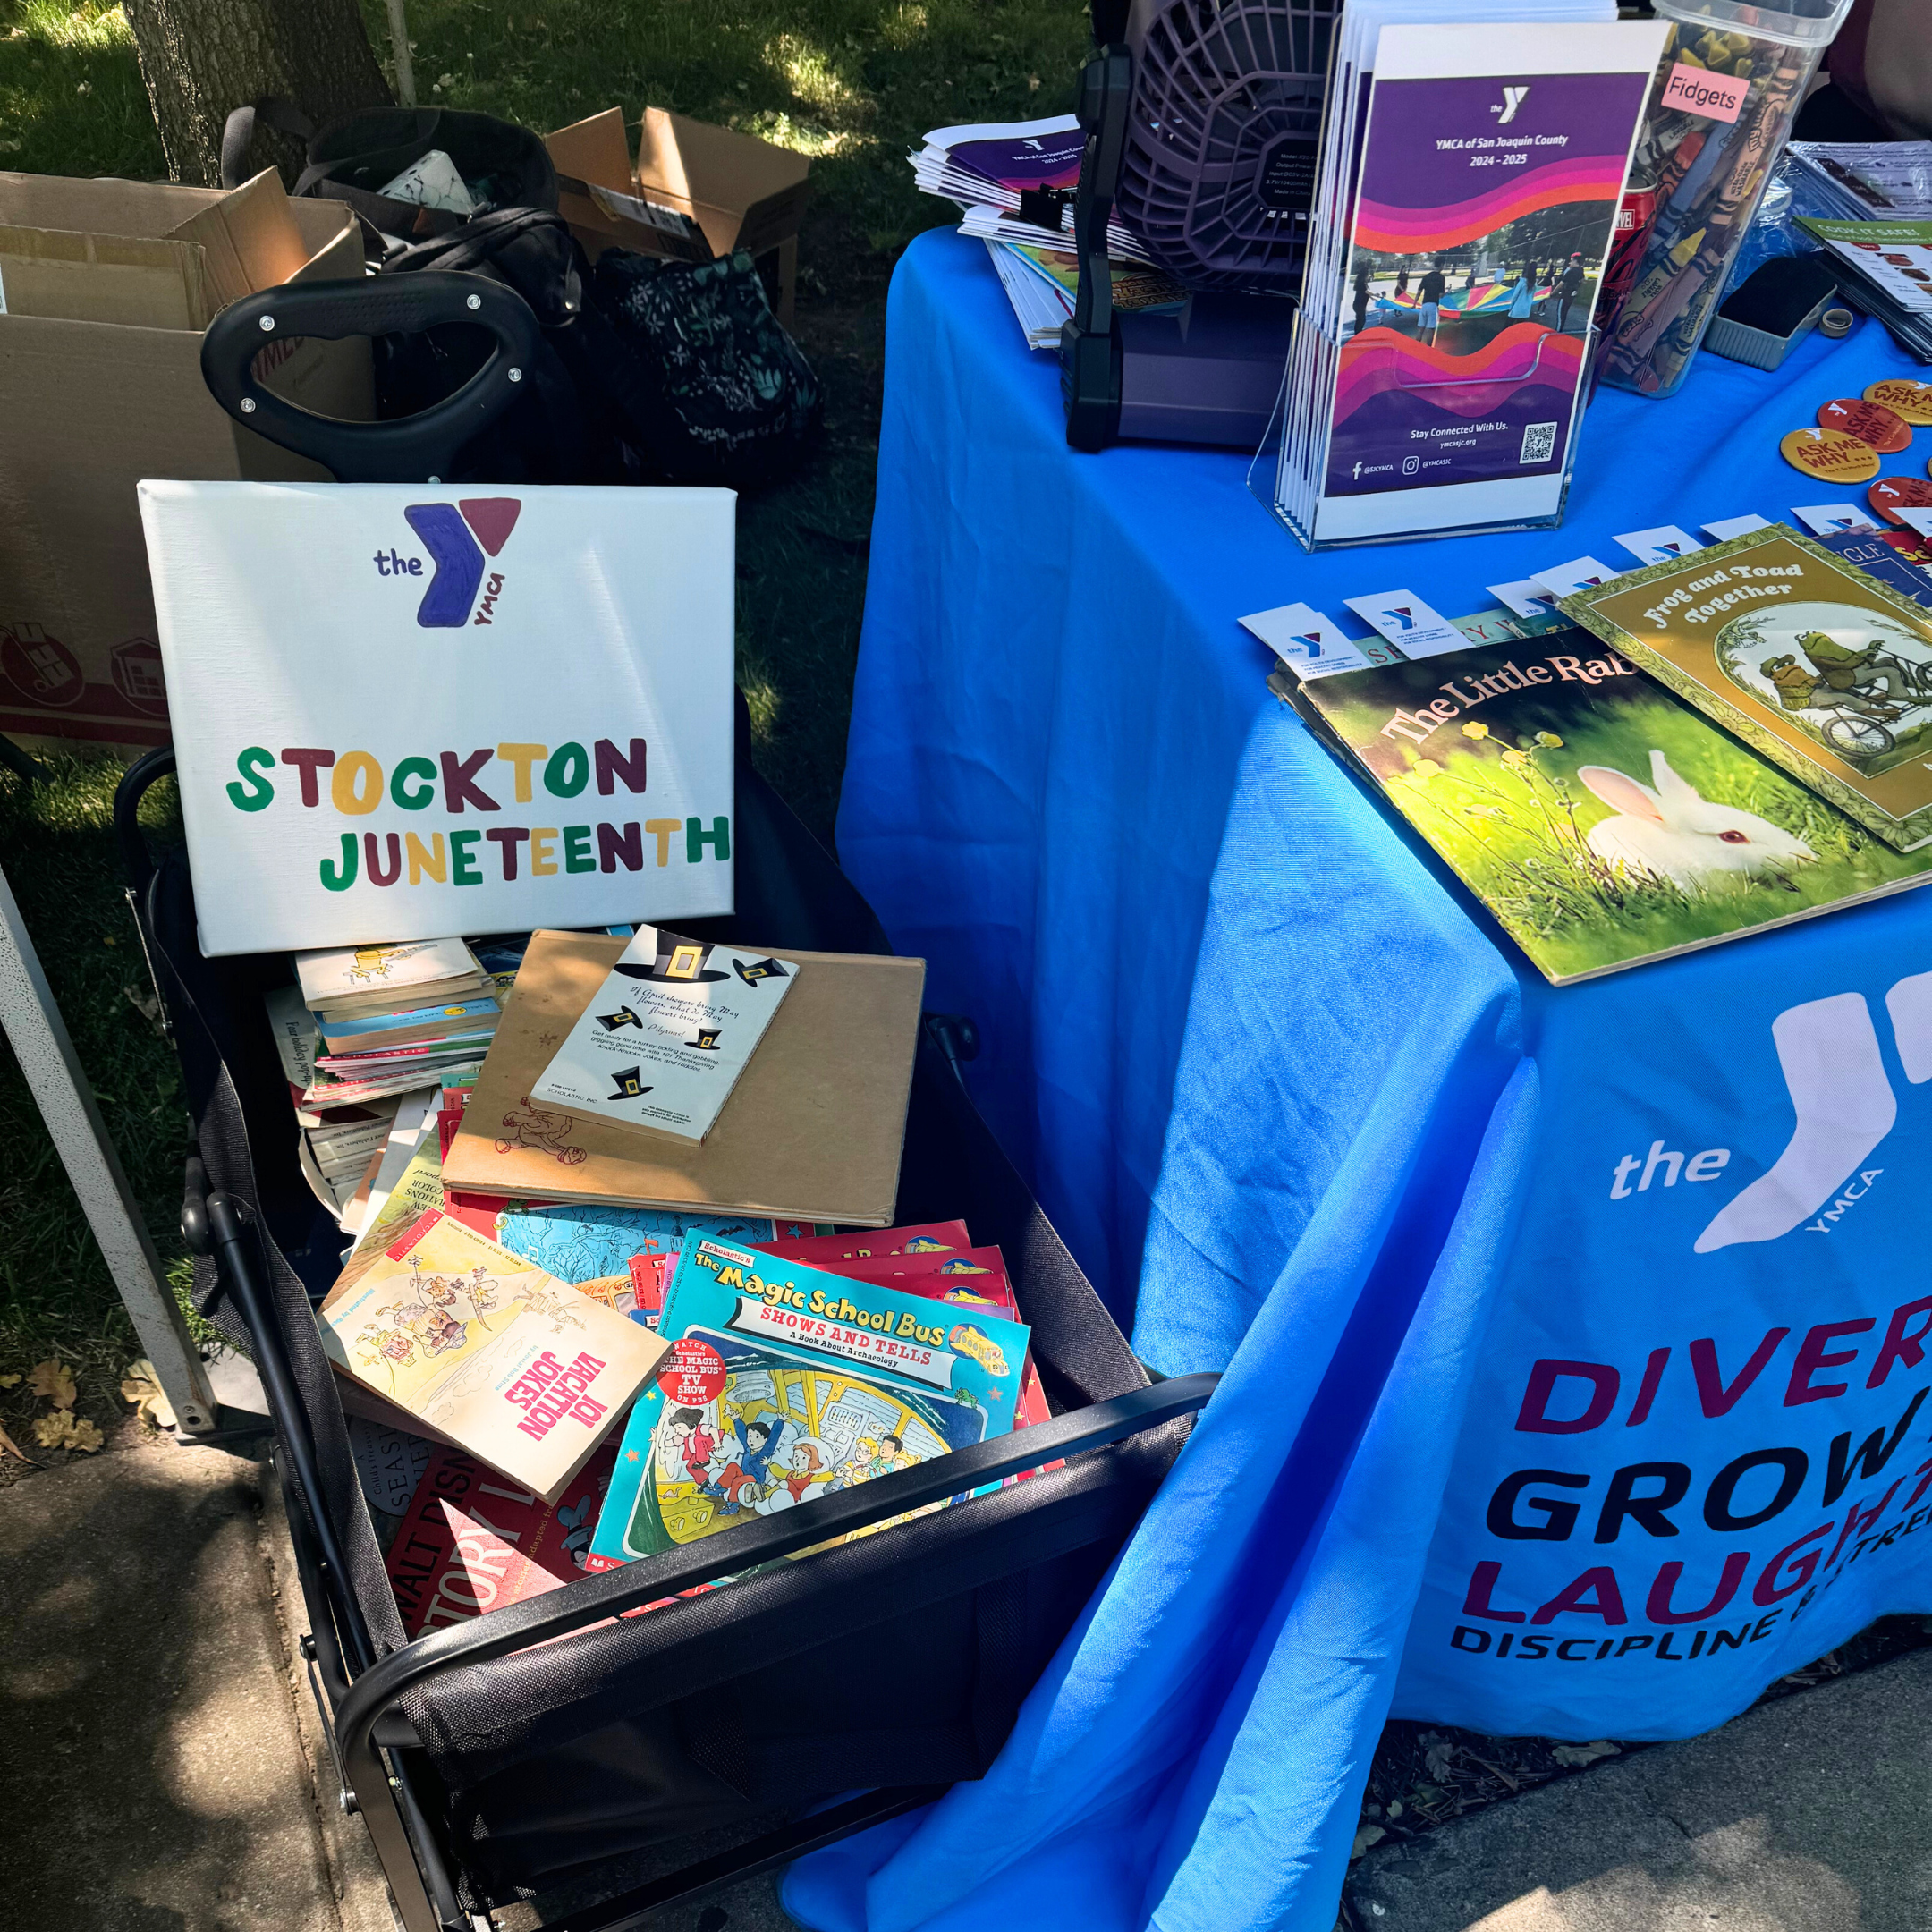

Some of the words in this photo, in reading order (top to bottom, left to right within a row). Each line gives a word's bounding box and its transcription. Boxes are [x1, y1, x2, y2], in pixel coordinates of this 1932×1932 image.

[1668, 76, 1737, 110] Fidgets
[1489, 104, 1504, 114] the
[1436, 139, 1464, 150] YMCA
[1465, 140, 1477, 149] of
[1477, 138, 1495, 148] San
[1496, 135, 1533, 148] Joaquin
[1534, 134, 1568, 148] County
[1470, 155, 1495, 167] 2024
[1502, 153, 1528, 165] 2025
[1876, 384, 1921, 399] ASK
[1411, 429, 1429, 439] Stay
[1430, 424, 1475, 437] Connected
[1476, 422, 1495, 433] With
[1496, 421, 1509, 430] Us.
[1843, 414, 1867, 440] ASK
[1859, 401, 1880, 418] ME
[1440, 438, 1477, 449] ymcasjc.org
[1796, 441, 1833, 459] ASK
[1833, 438, 1866, 451] ME
[373, 548, 424, 577] the
[1652, 555, 1667, 563] the
[1643, 588, 1693, 629] Frog
[1689, 570, 1732, 591] and
[1731, 564, 1804, 578] Toad
[1684, 584, 1792, 624] Together
[1525, 607, 1541, 615] the
[1380, 694, 1461, 745] The
[1439, 657, 1558, 709] Little
[225, 737, 648, 816] STOCKTON
[319, 815, 731, 893] JUNETEENTH
[630, 986, 642, 996] If
[642, 988, 665, 1000] April
[666, 995, 694, 1006] showers
[696, 1001, 717, 1013] bring
[718, 1005, 740, 1019] May
[648, 1006, 676, 1018] flowers
[669, 1004, 690, 1013] what
[702, 1009, 723, 1023] May
[285, 1021, 300, 1037] Four
[604, 1033, 623, 1042] ready
[648, 1023, 686, 1038] Pilgrims!
[674, 1055, 715, 1070] Thanksgiving
[547, 1088, 585, 1101] SCHOLASTIC
[1609, 1139, 1732, 1201] the
[411, 1179, 444, 1195] COLOR
[1804, 1165, 1885, 1235] YMCA
[394, 1220, 436, 1261] SCHOLASTIC
[704, 1242, 751, 1264] Scholastic's
[694, 1253, 720, 1273] The
[714, 1266, 807, 1309] Magic
[809, 1290, 895, 1333] School
[895, 1312, 946, 1348] Bus
[760, 1307, 826, 1336] SHOWS
[829, 1327, 870, 1348] AND
[875, 1339, 932, 1366] TELLS
[530, 1344, 539, 1352] by
[790, 1331, 796, 1339] A
[798, 1334, 818, 1346] Book
[820, 1340, 846, 1353] About
[847, 1346, 899, 1368] Archaeology
[516, 1352, 532, 1368] Jovial
[660, 1364, 698, 1374] SCHOOL
[686, 1356, 719, 1366] MAGIC
[504, 1351, 565, 1411] JOKES
[506, 1368, 520, 1378] Bob
[681, 1374, 702, 1385] TV
[495, 1377, 510, 1392] Stine
[677, 1385, 708, 1394] SHOW
[516, 1352, 606, 1442] VACATION
[677, 1394, 690, 1403] ON
[692, 1395, 708, 1403] PBS
[367, 1470, 383, 1496] Child's
[528, 1520, 550, 1563] adapted
[396, 1531, 443, 1621] WALT
[1450, 1605, 1785, 1662] DISCIPLINE
